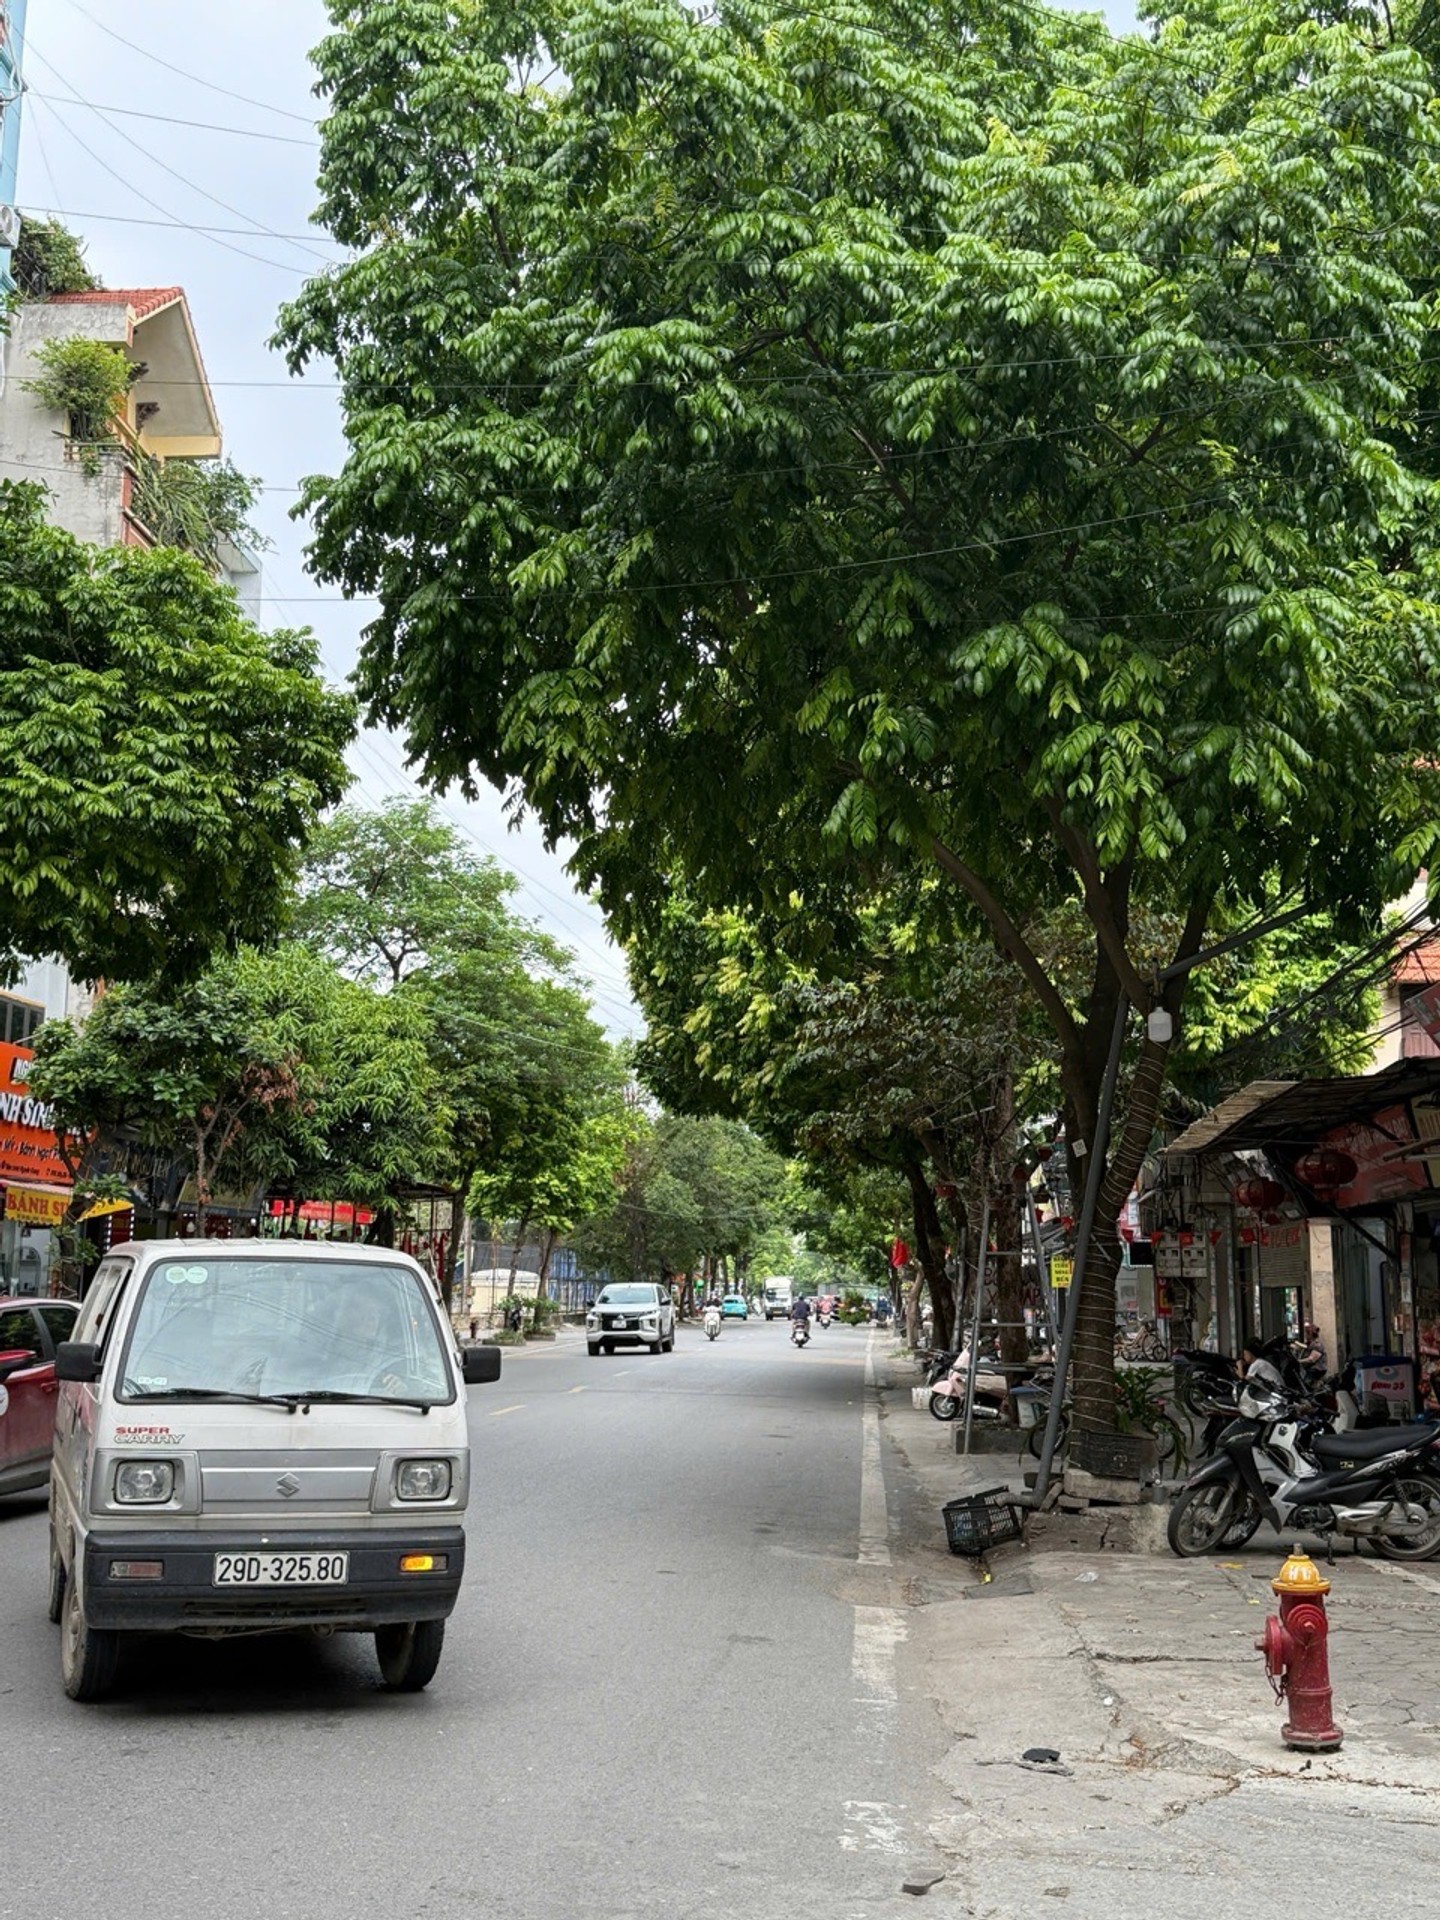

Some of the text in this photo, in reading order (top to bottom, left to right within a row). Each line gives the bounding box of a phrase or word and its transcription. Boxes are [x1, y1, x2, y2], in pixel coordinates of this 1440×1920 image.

[7, 1190, 49, 1216] BÁNH
[113, 1433, 186, 1445] CARRY
[115, 1426, 170, 1435] SUPER
[217, 1556, 345, 1582] 29D-325.80
